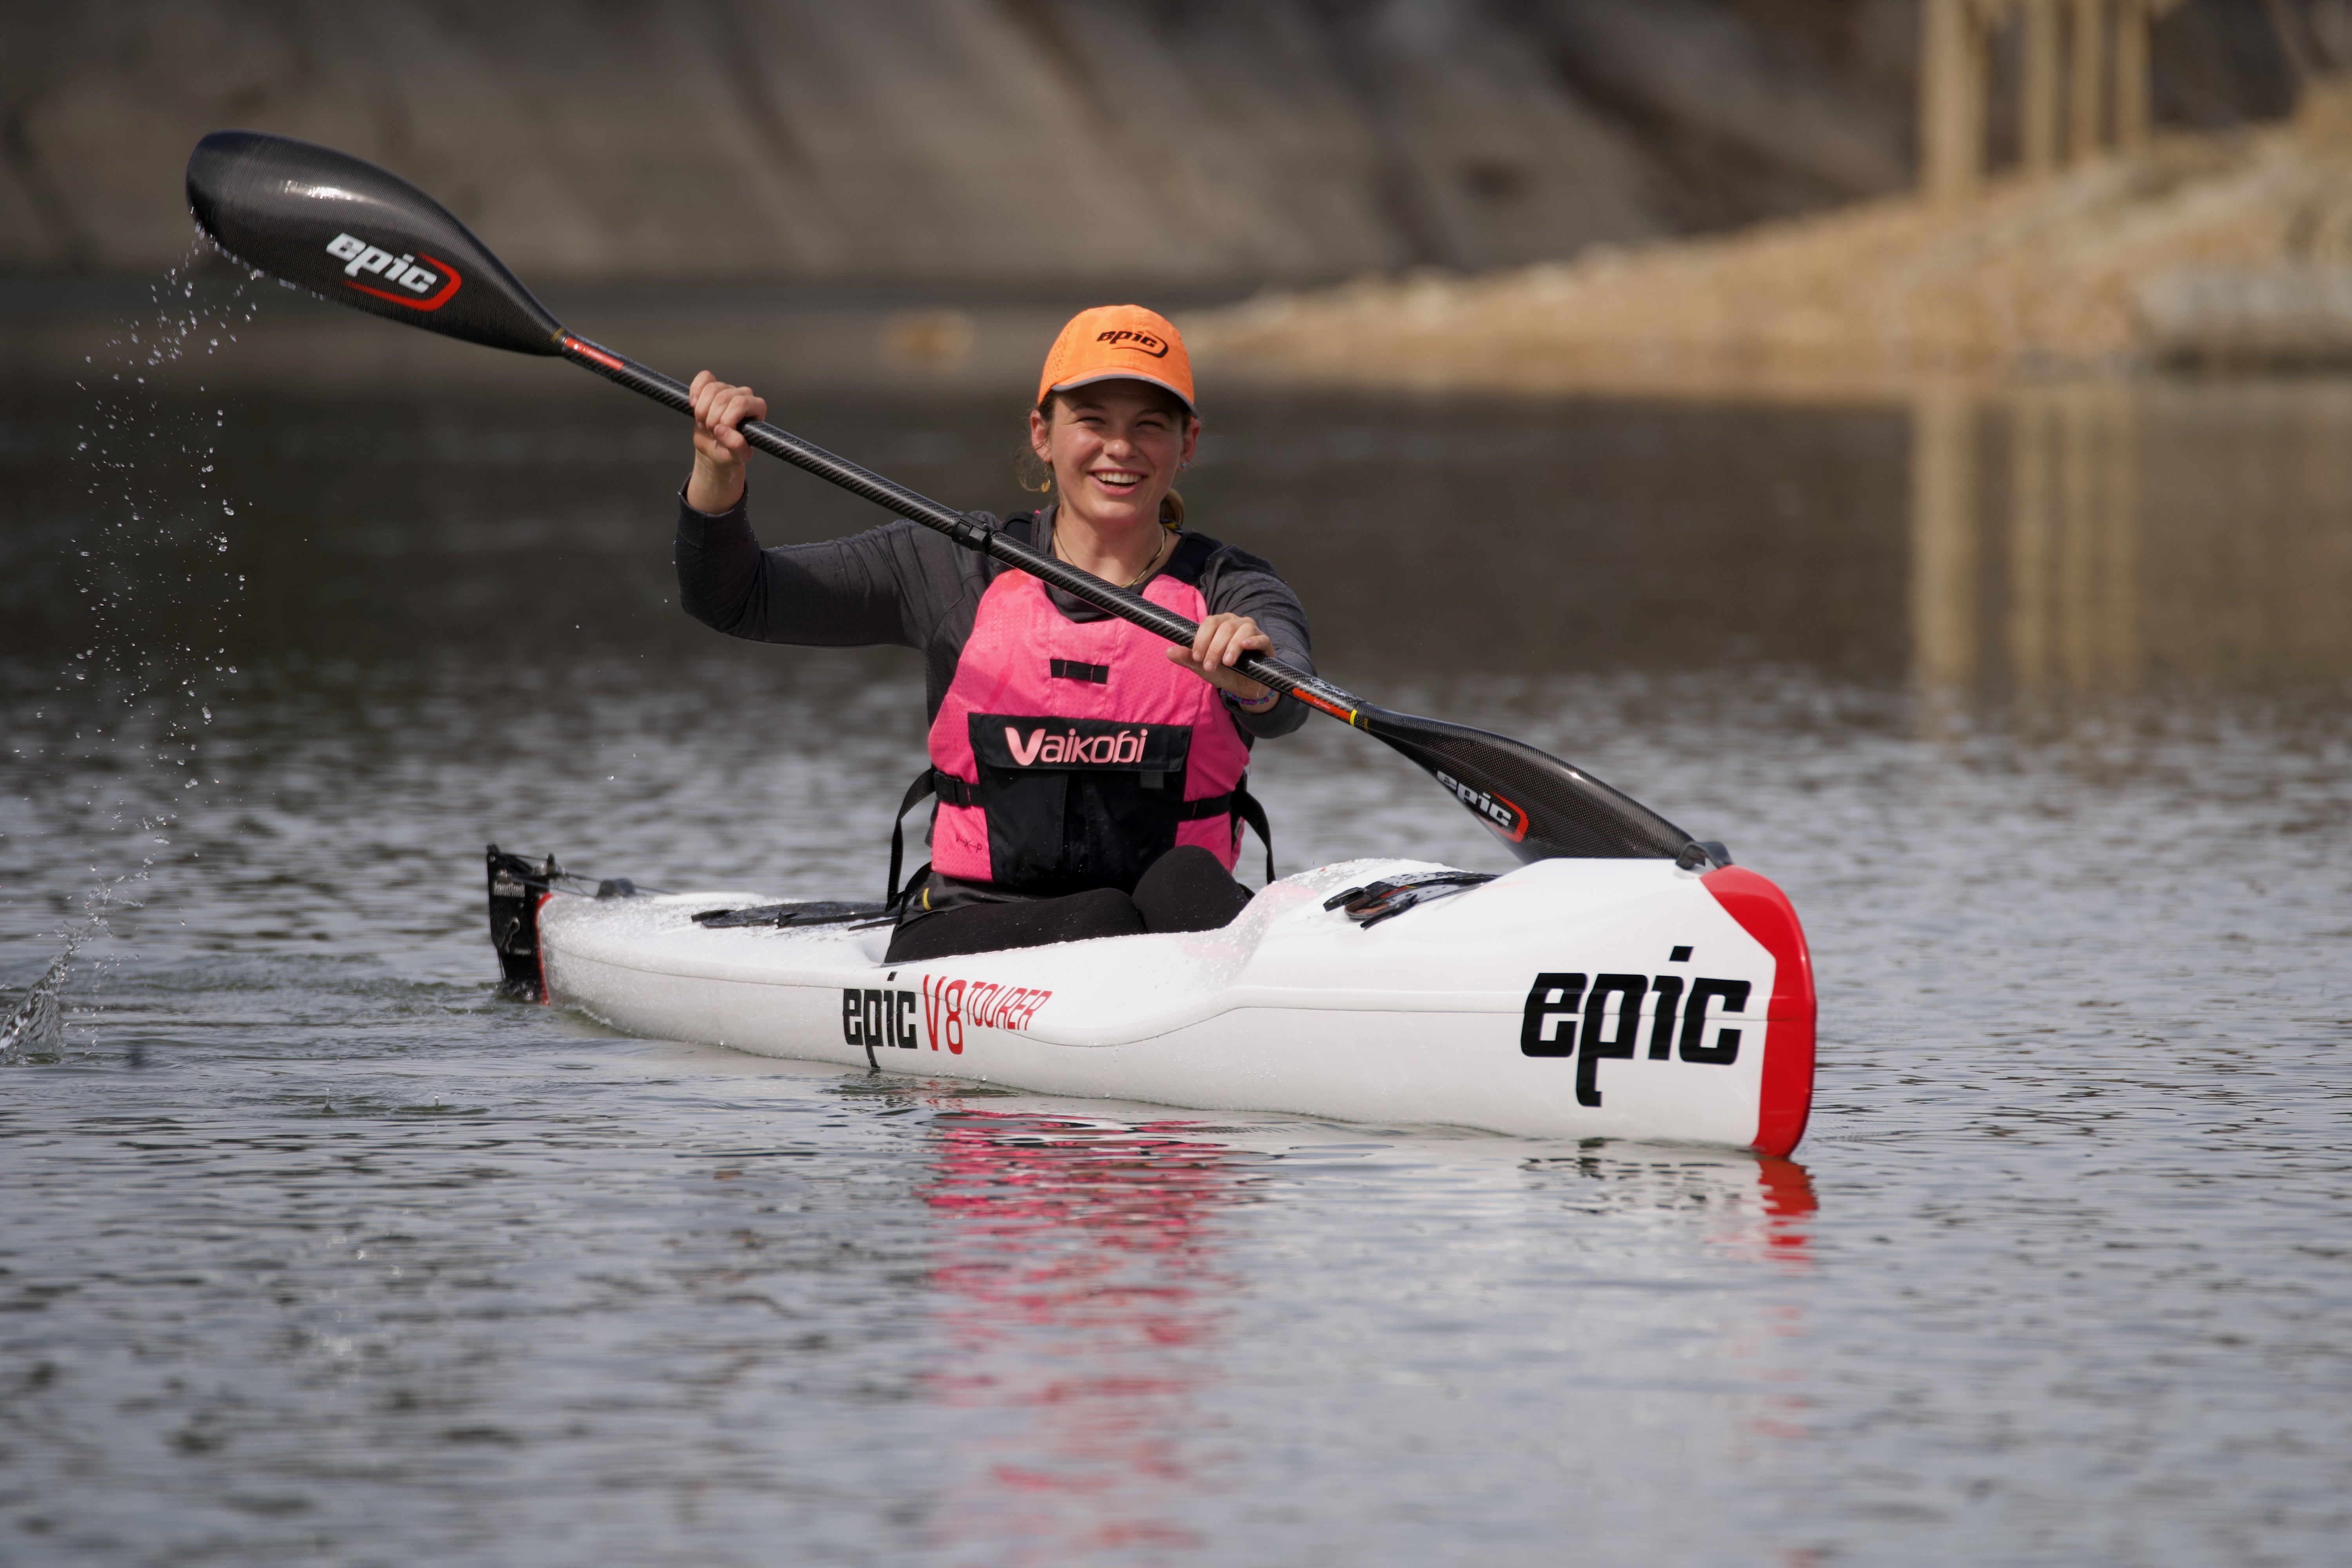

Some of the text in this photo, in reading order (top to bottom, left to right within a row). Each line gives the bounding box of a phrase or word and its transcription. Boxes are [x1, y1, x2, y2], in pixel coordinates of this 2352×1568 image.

[326, 232, 437, 294] epic
[1096, 331, 1158, 347] epic
[1004, 727, 1148, 766] Vaikobi
[1436, 770, 1512, 827] epic
[843, 971, 1053, 1069] epic V8 TOURER
[1520, 945, 1751, 1108] epic
